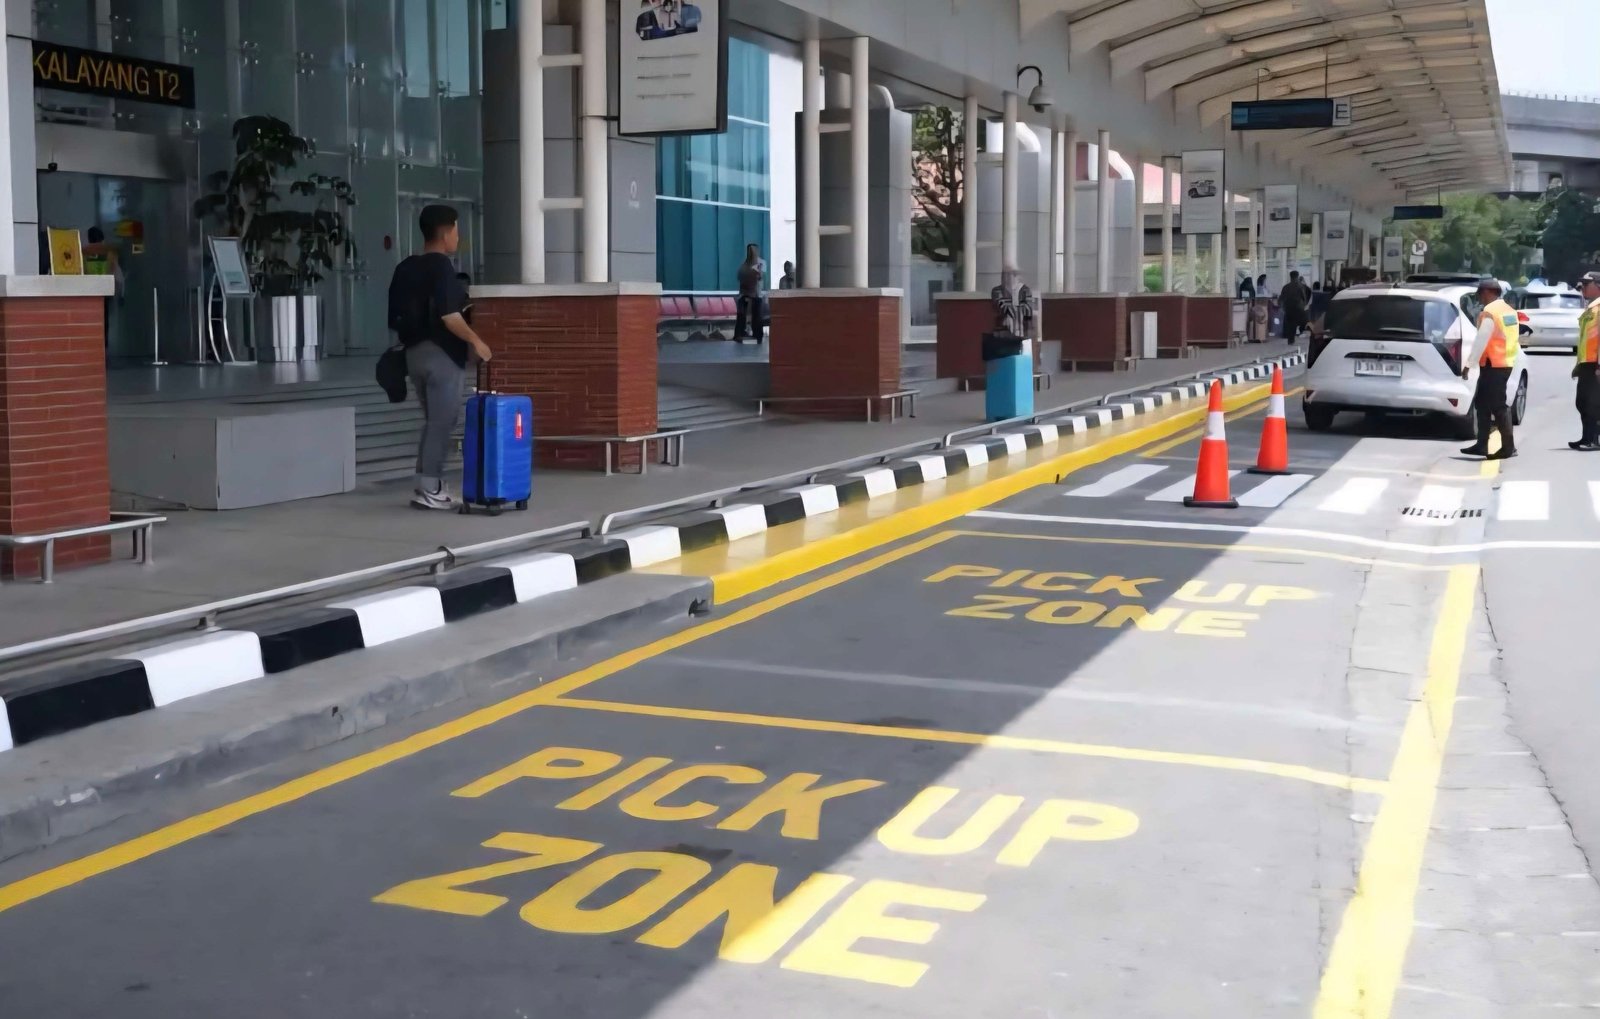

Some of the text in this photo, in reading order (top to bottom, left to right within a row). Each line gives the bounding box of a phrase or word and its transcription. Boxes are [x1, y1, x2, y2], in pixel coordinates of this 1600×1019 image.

[155, 69, 181, 100] T2
[923, 564, 1325, 606] PICK UP
[944, 594, 1261, 638] ZONE
[450, 746, 1140, 867] PICK UP
[373, 832, 987, 988] ZONE
